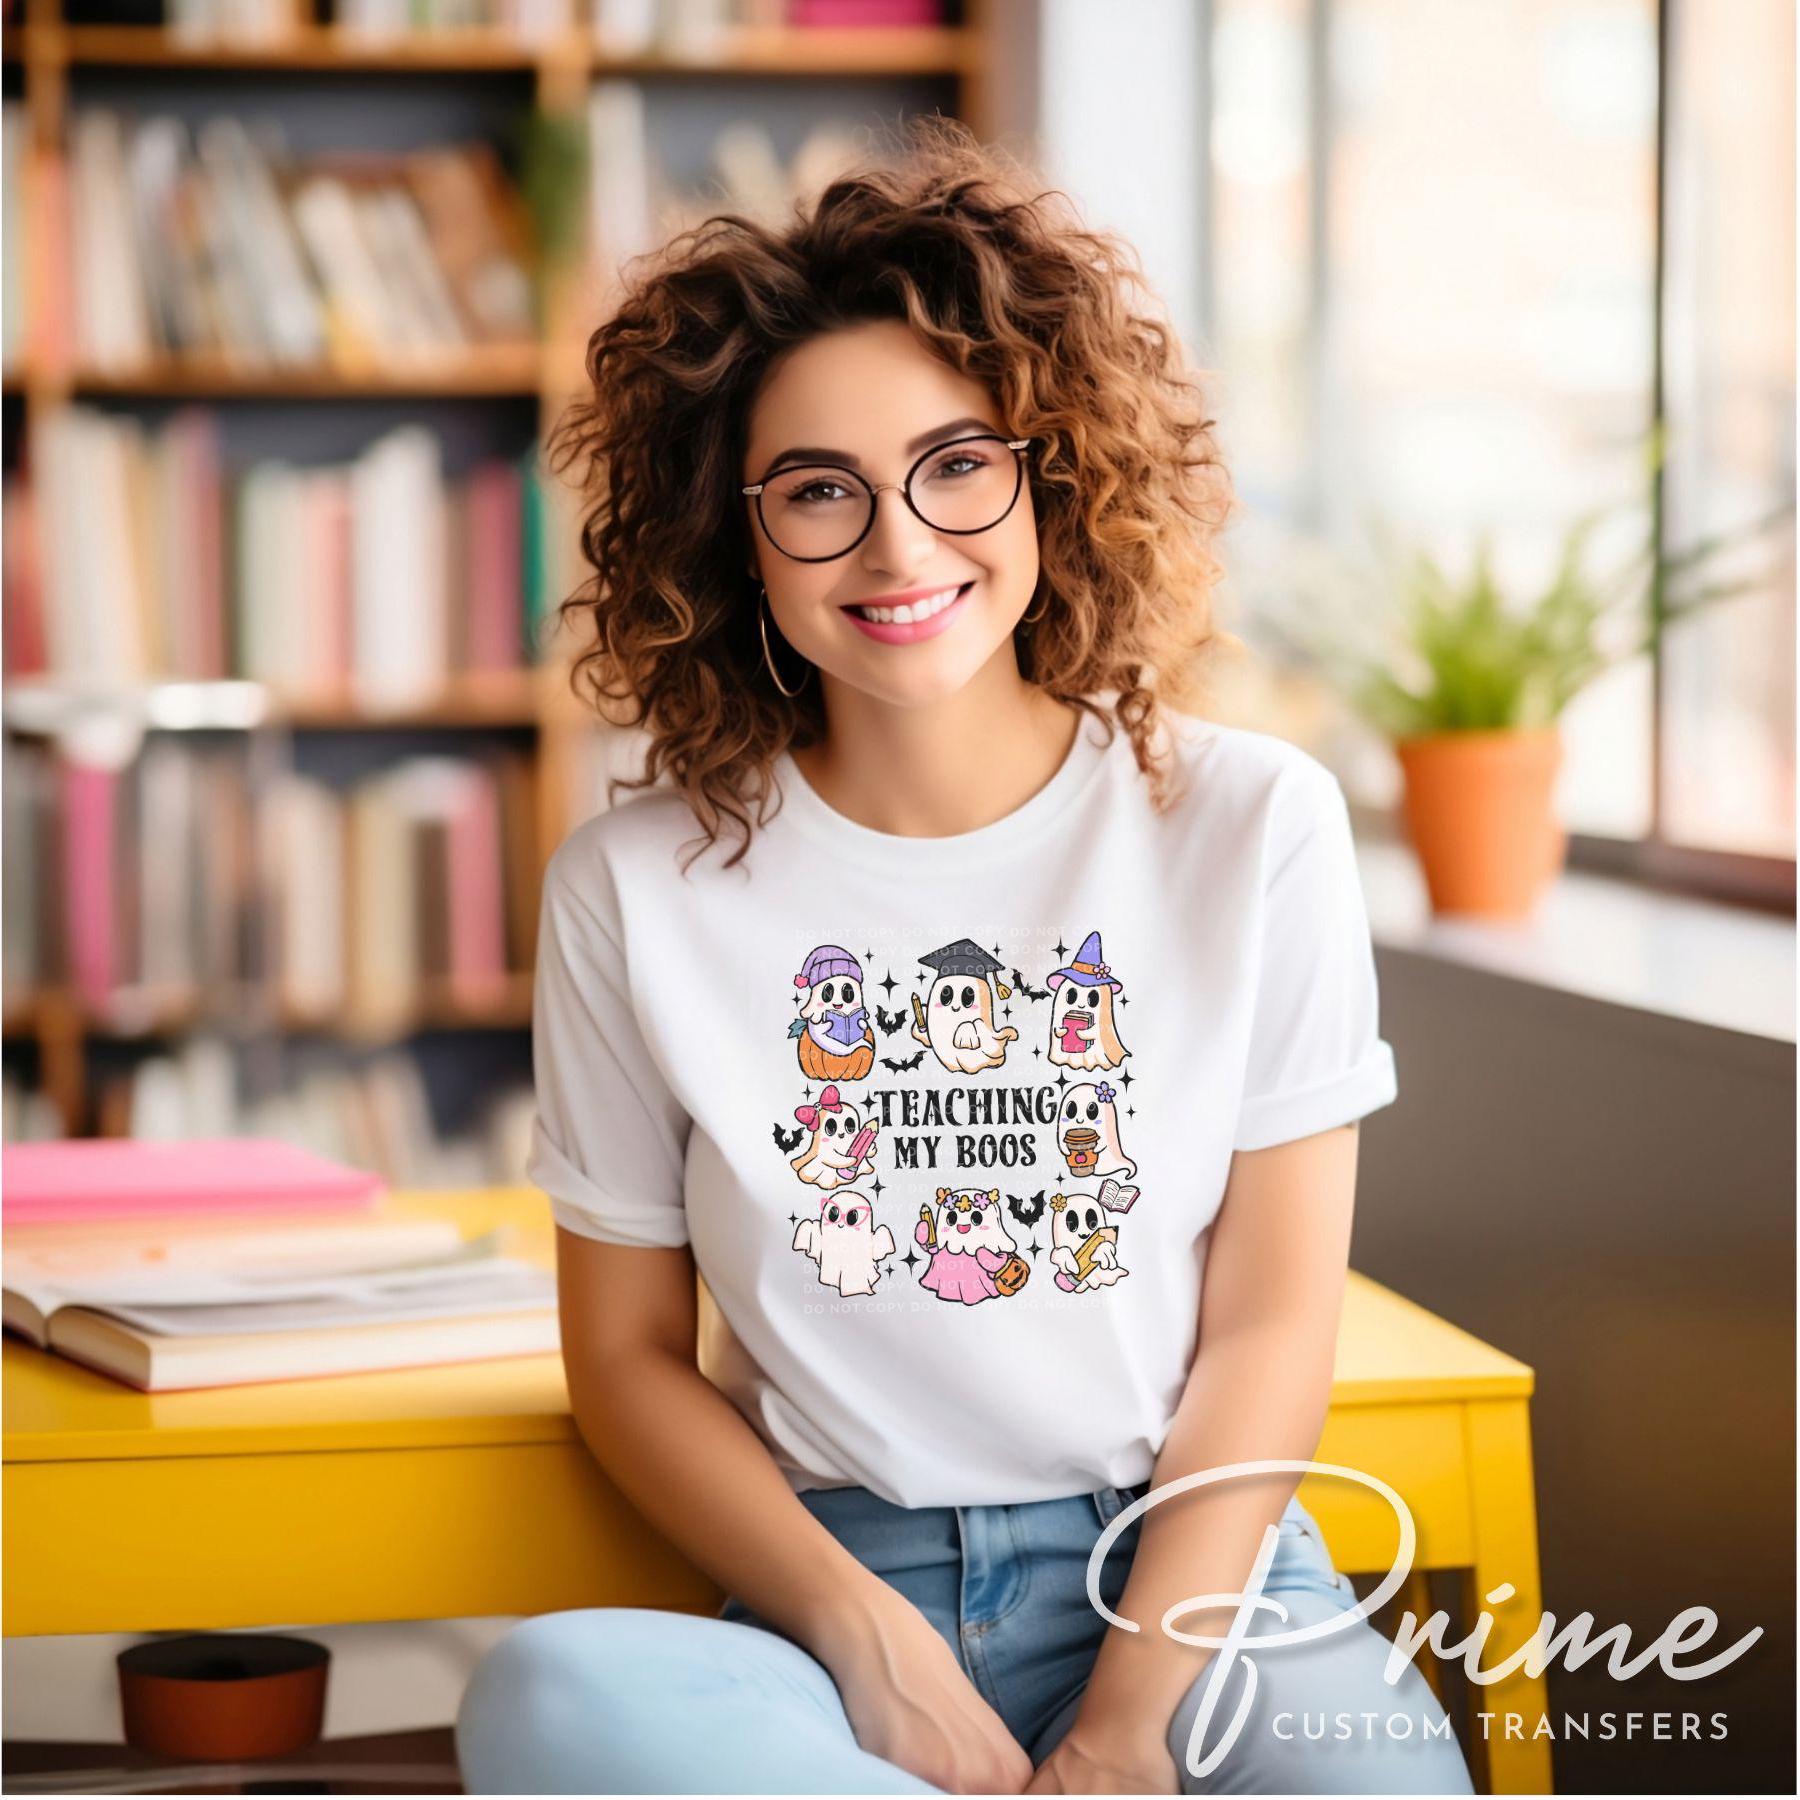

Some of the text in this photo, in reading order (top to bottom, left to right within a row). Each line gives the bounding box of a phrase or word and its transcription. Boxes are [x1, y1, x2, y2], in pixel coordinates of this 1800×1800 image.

[873, 1086, 1058, 1128] TEACHING
[893, 1133, 1037, 1170] MY BOOS
